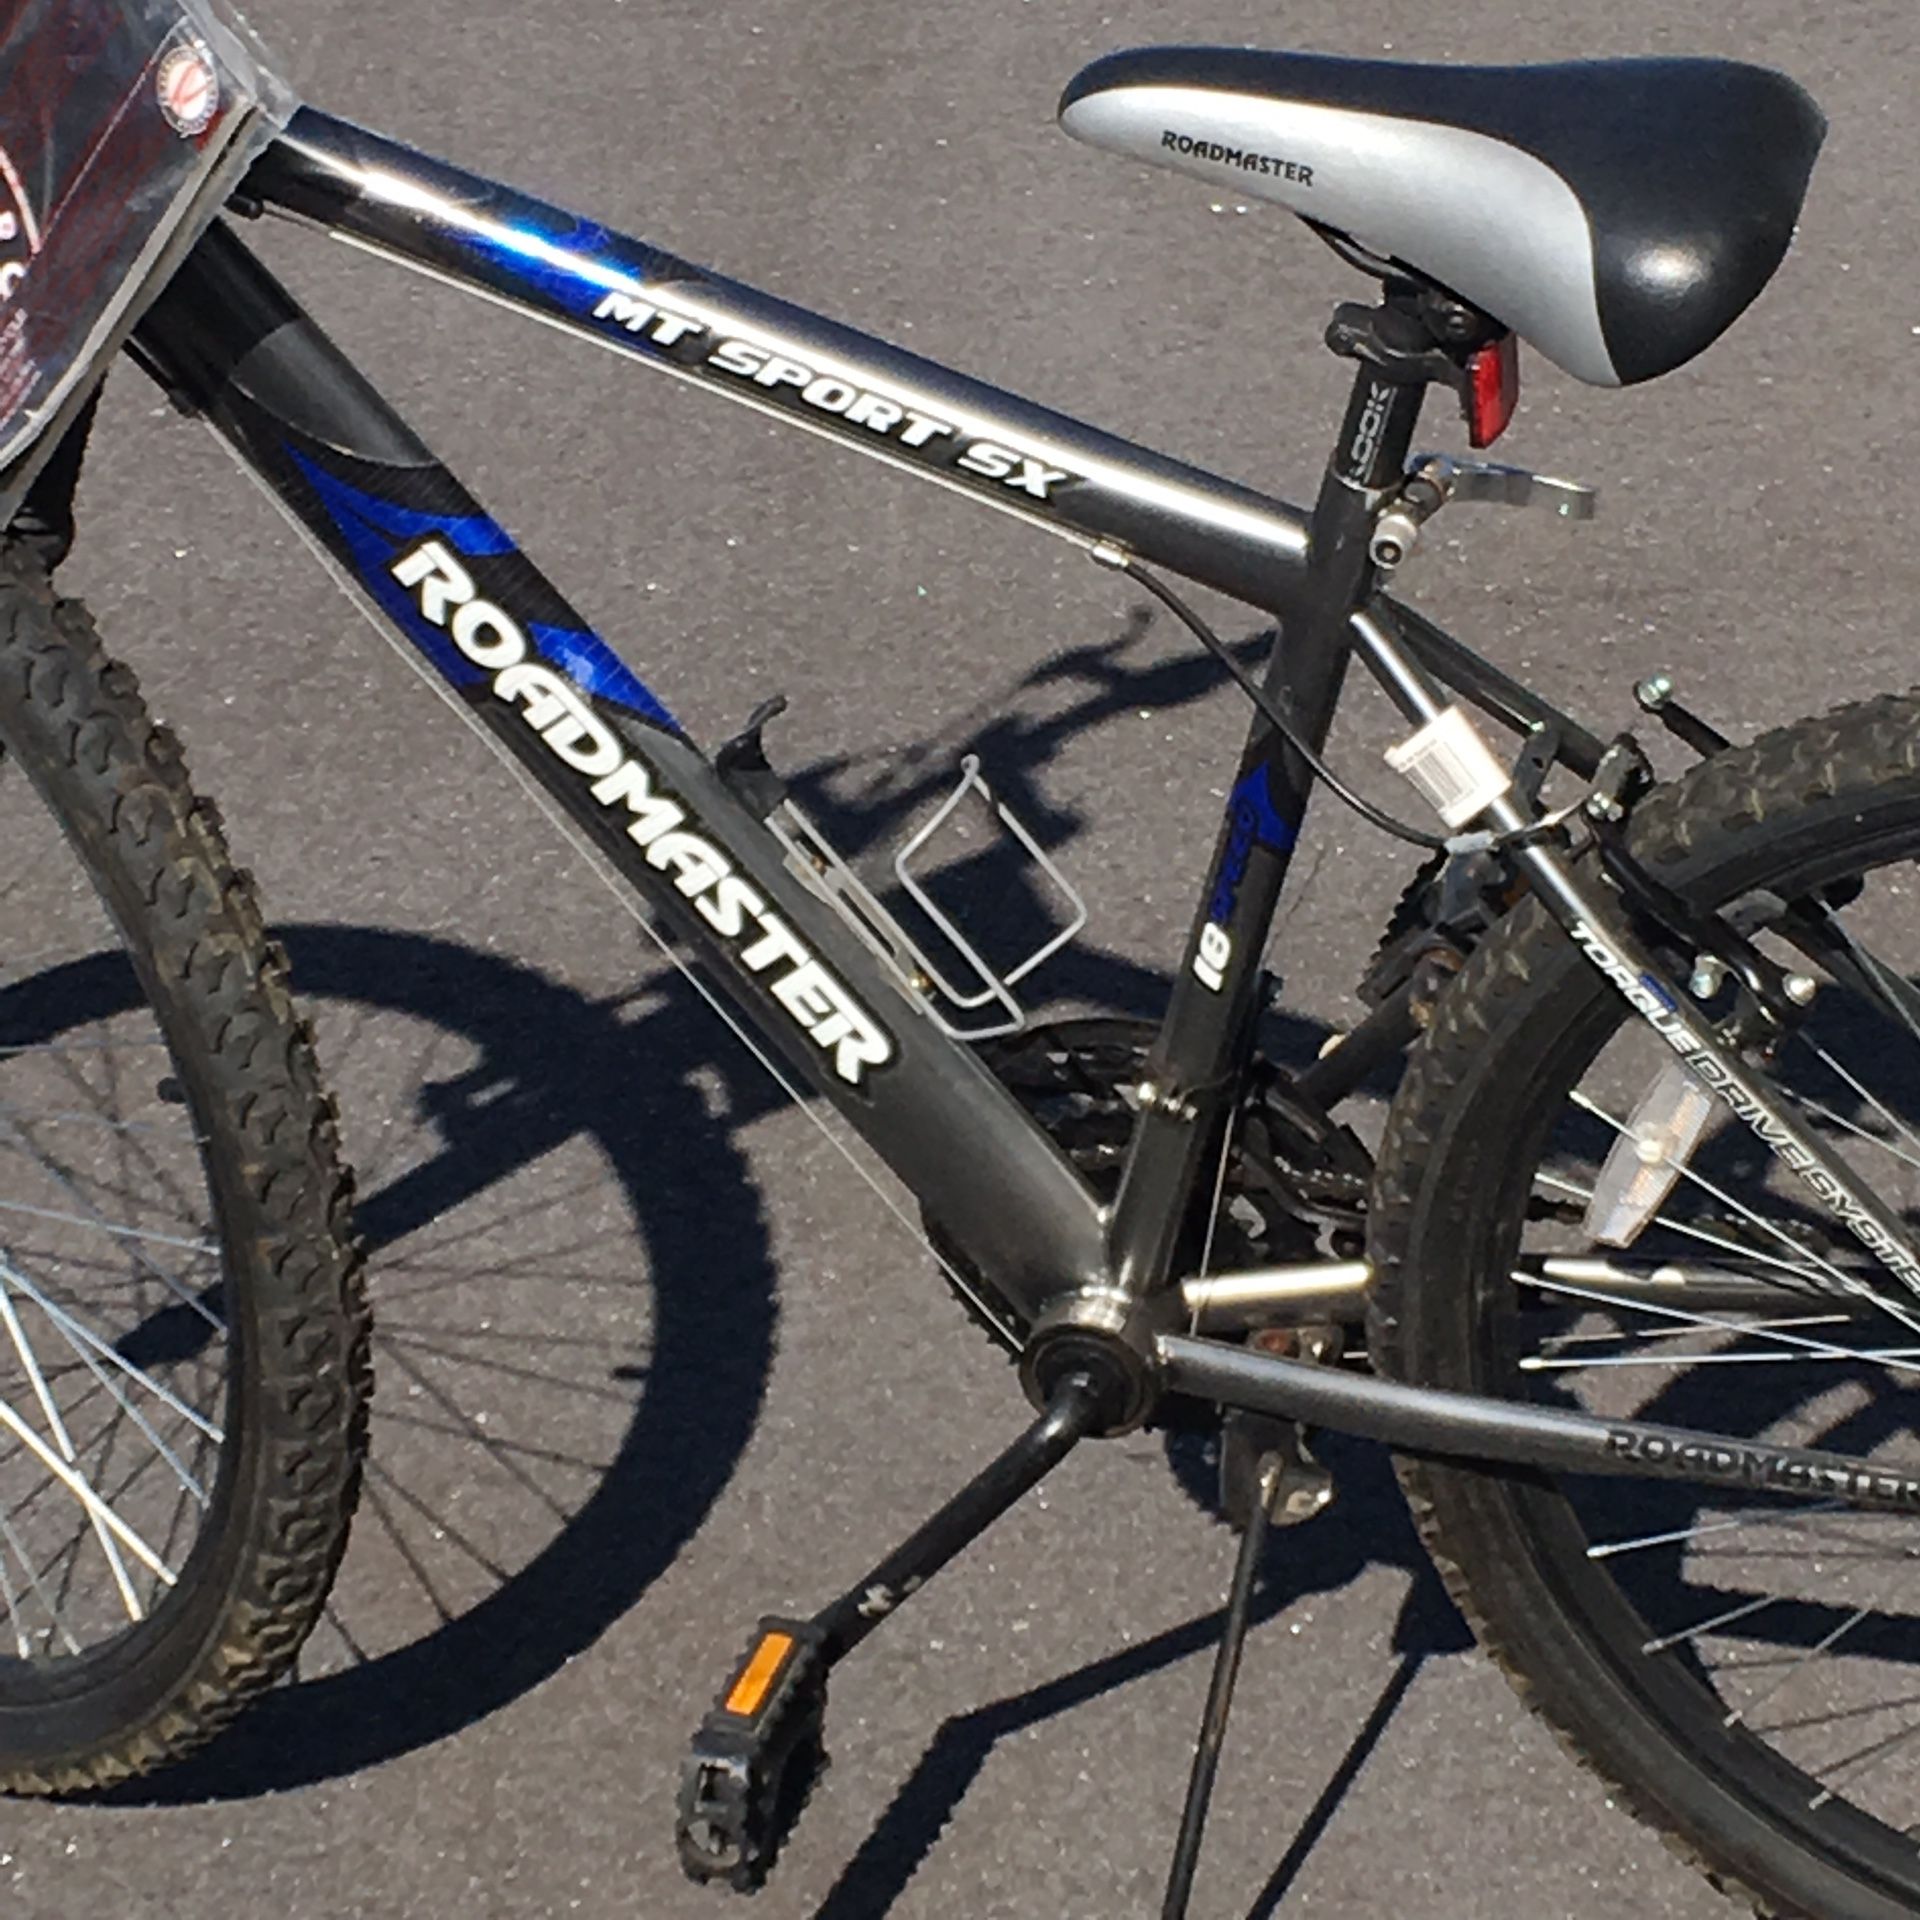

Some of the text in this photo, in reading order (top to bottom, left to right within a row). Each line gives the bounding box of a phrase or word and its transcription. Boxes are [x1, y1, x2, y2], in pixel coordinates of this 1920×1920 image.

[1161, 129, 1315, 187] ROADMASTER
[593, 292, 1068, 499] MT SPORT SX
[390, 540, 893, 1086] ROADMASTER
[1193, 920, 1232, 992] 18
[1570, 920, 1701, 1054] TORQUE
[1684, 1048, 1815, 1173] DRIVE
